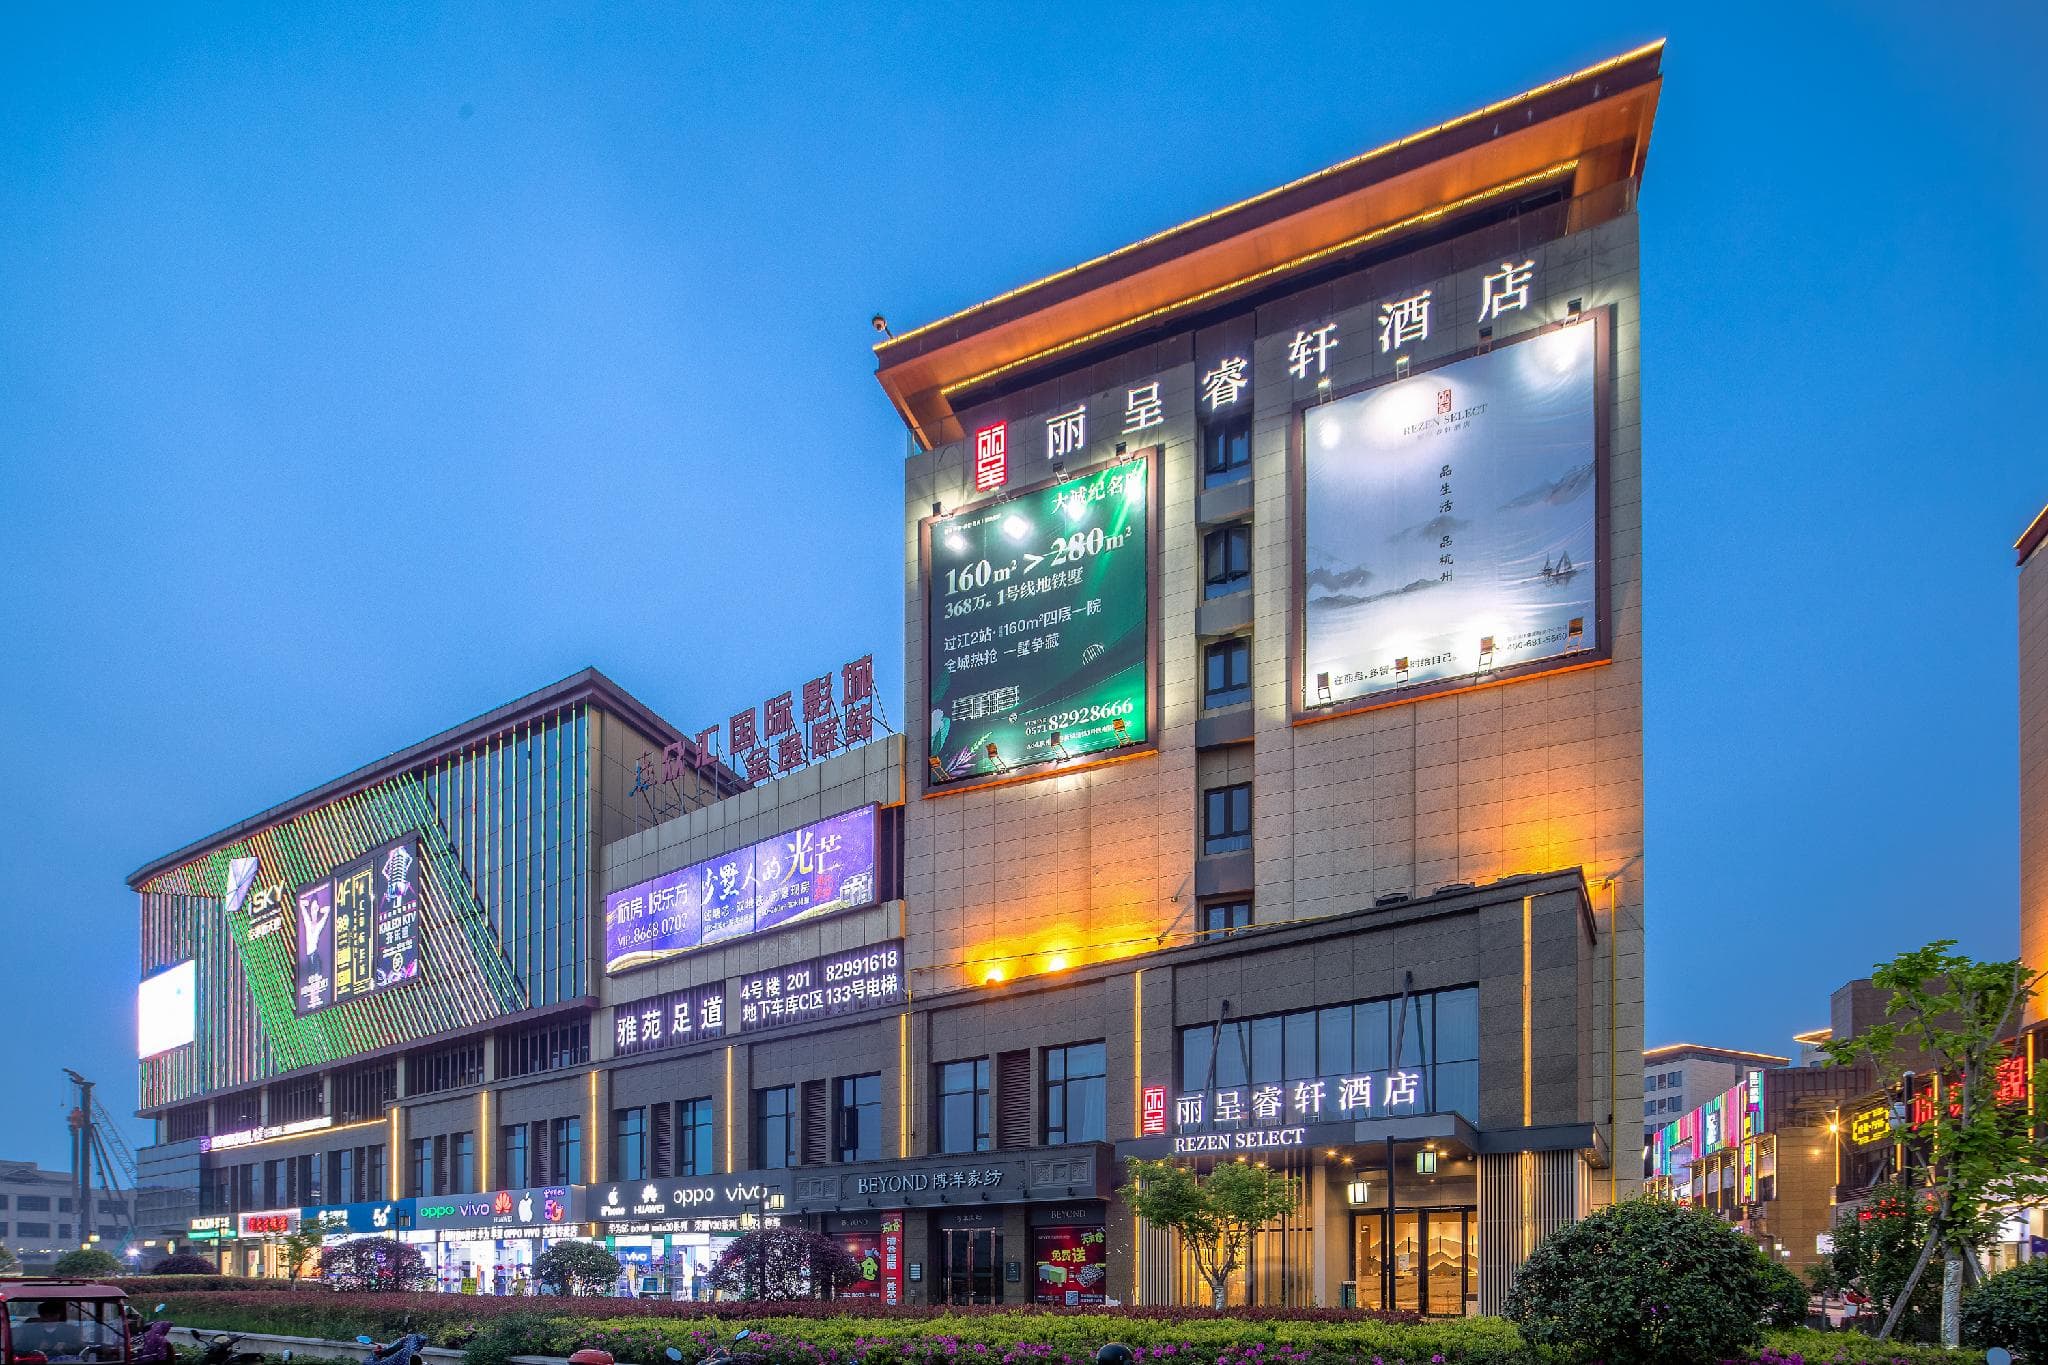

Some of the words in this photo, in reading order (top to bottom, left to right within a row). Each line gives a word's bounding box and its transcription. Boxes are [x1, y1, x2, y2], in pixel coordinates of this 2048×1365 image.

[1046, 260, 1536, 460] 丽呈睿轩酒店
[1444, 402, 1488, 424] SELECT
[1439, 464, 1454, 514] 品生活
[944, 648, 998, 673] 全城热抢
[1048, 698, 1134, 731] 82928666
[741, 976, 781, 999] 4号楼
[787, 971, 811, 991] 201
[826, 950, 898, 982] 82991618
[617, 996, 723, 1047] 雅苑足道
[1176, 1071, 1419, 1126] 丽呈睿轩酒店
[1174, 1133, 1231, 1153] REZEN
[1235, 1128, 1305, 1148] SELECT
[857, 1174, 928, 1194] BEYOND
[931, 1168, 1004, 1189] 博洋家纺
[458, 1201, 490, 1217] vivo
[633, 1204, 665, 1215] HUAWEI
[673, 1188, 715, 1207] oppo
[420, 1206, 455, 1219] oppo
[626, 1251, 647, 1261] vivo
[1051, 1246, 1087, 1263] 免费送
